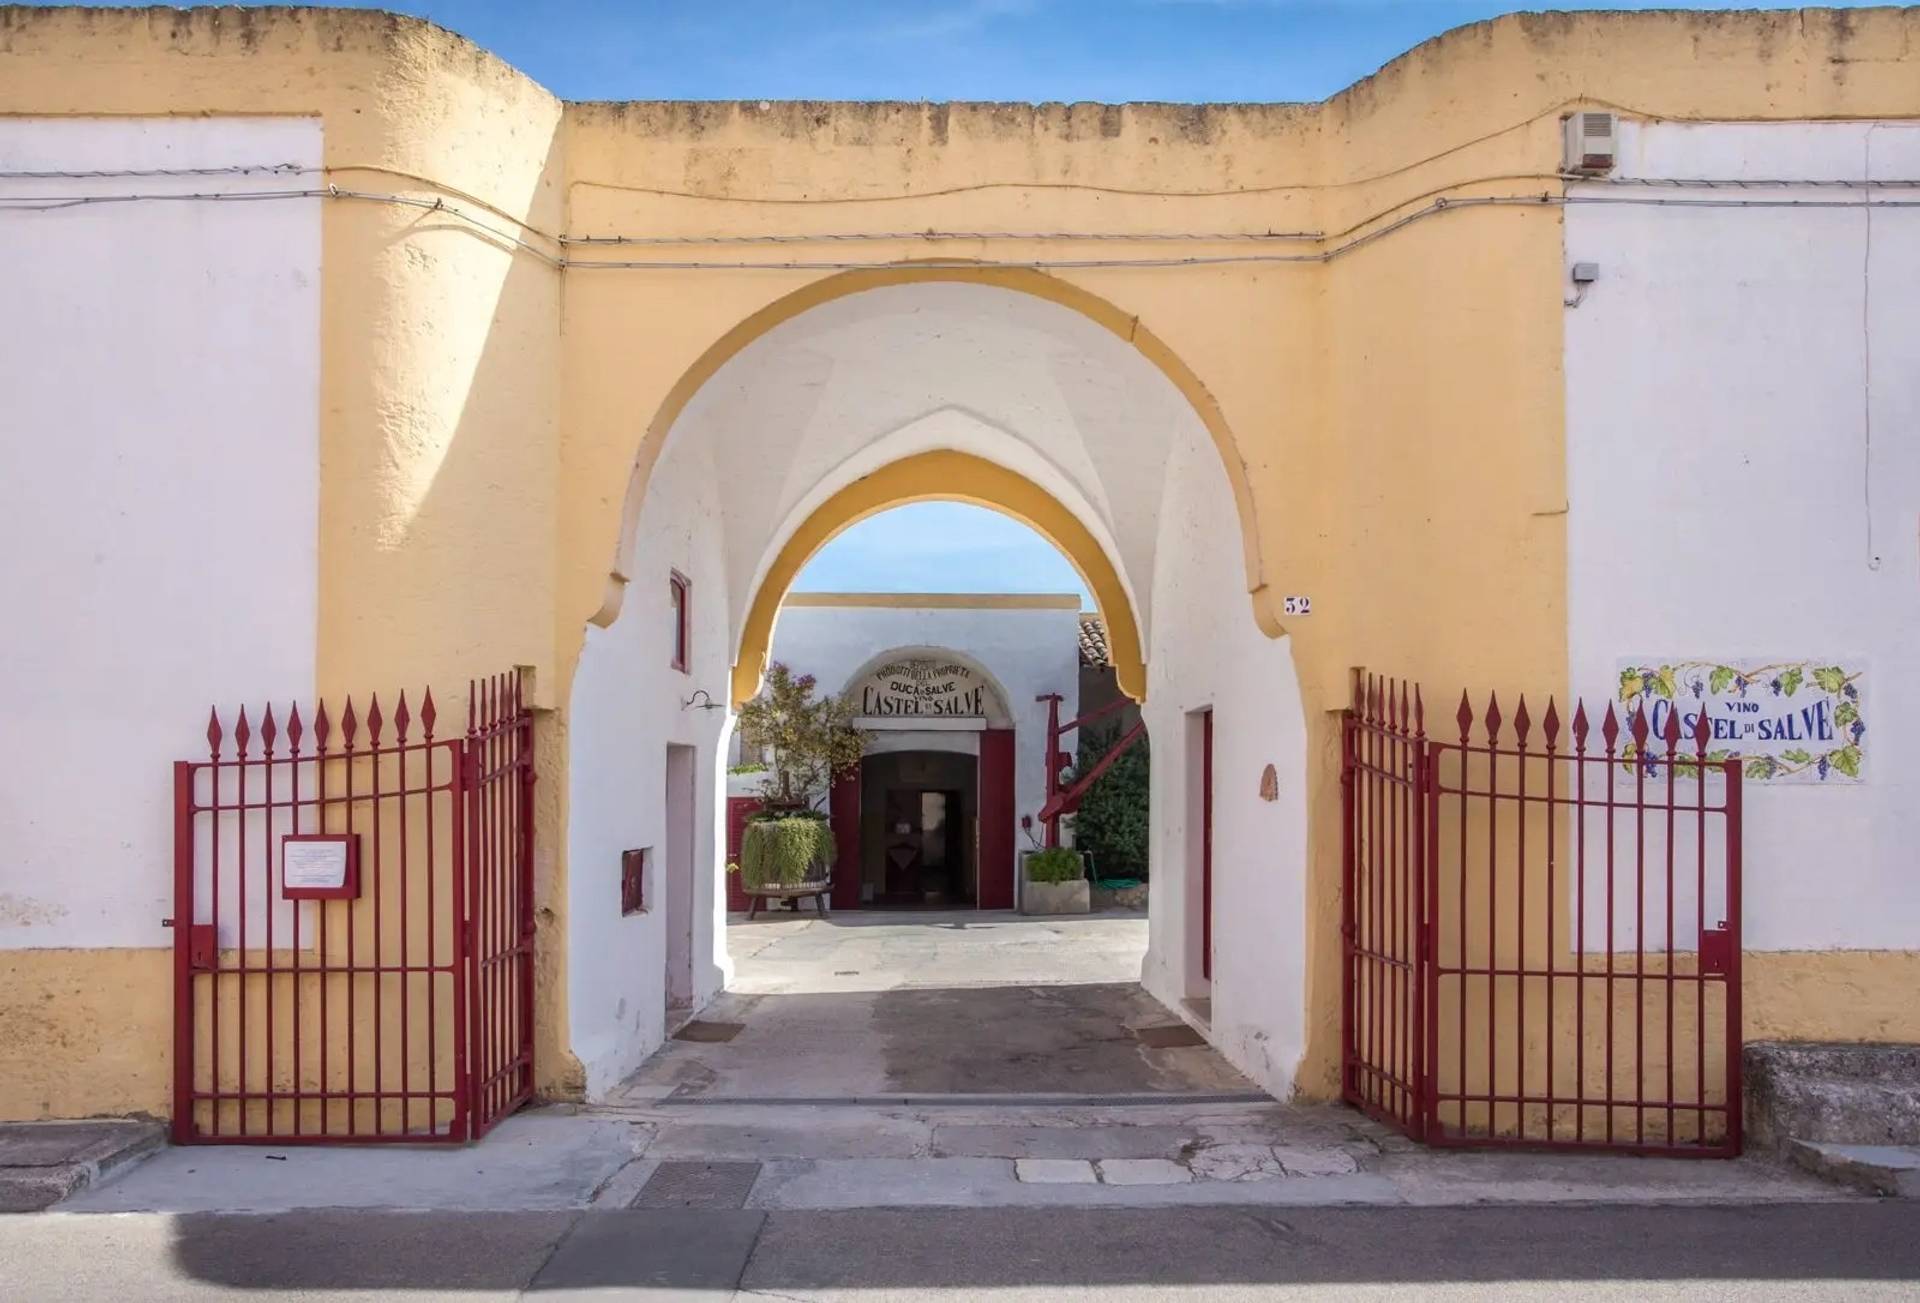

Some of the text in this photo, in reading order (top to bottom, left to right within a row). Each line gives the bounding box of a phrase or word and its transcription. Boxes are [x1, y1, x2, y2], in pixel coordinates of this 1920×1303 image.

[1286, 597, 1310, 613] 32
[890, 681, 920, 695] DUCA
[925, 681, 956, 695] SALVE
[862, 685, 923, 715] CASTEL
[934, 685, 985, 715] SALVE
[1725, 701, 1760, 713] VINO
[1652, 697, 1833, 741] CSEL DI SALVE
